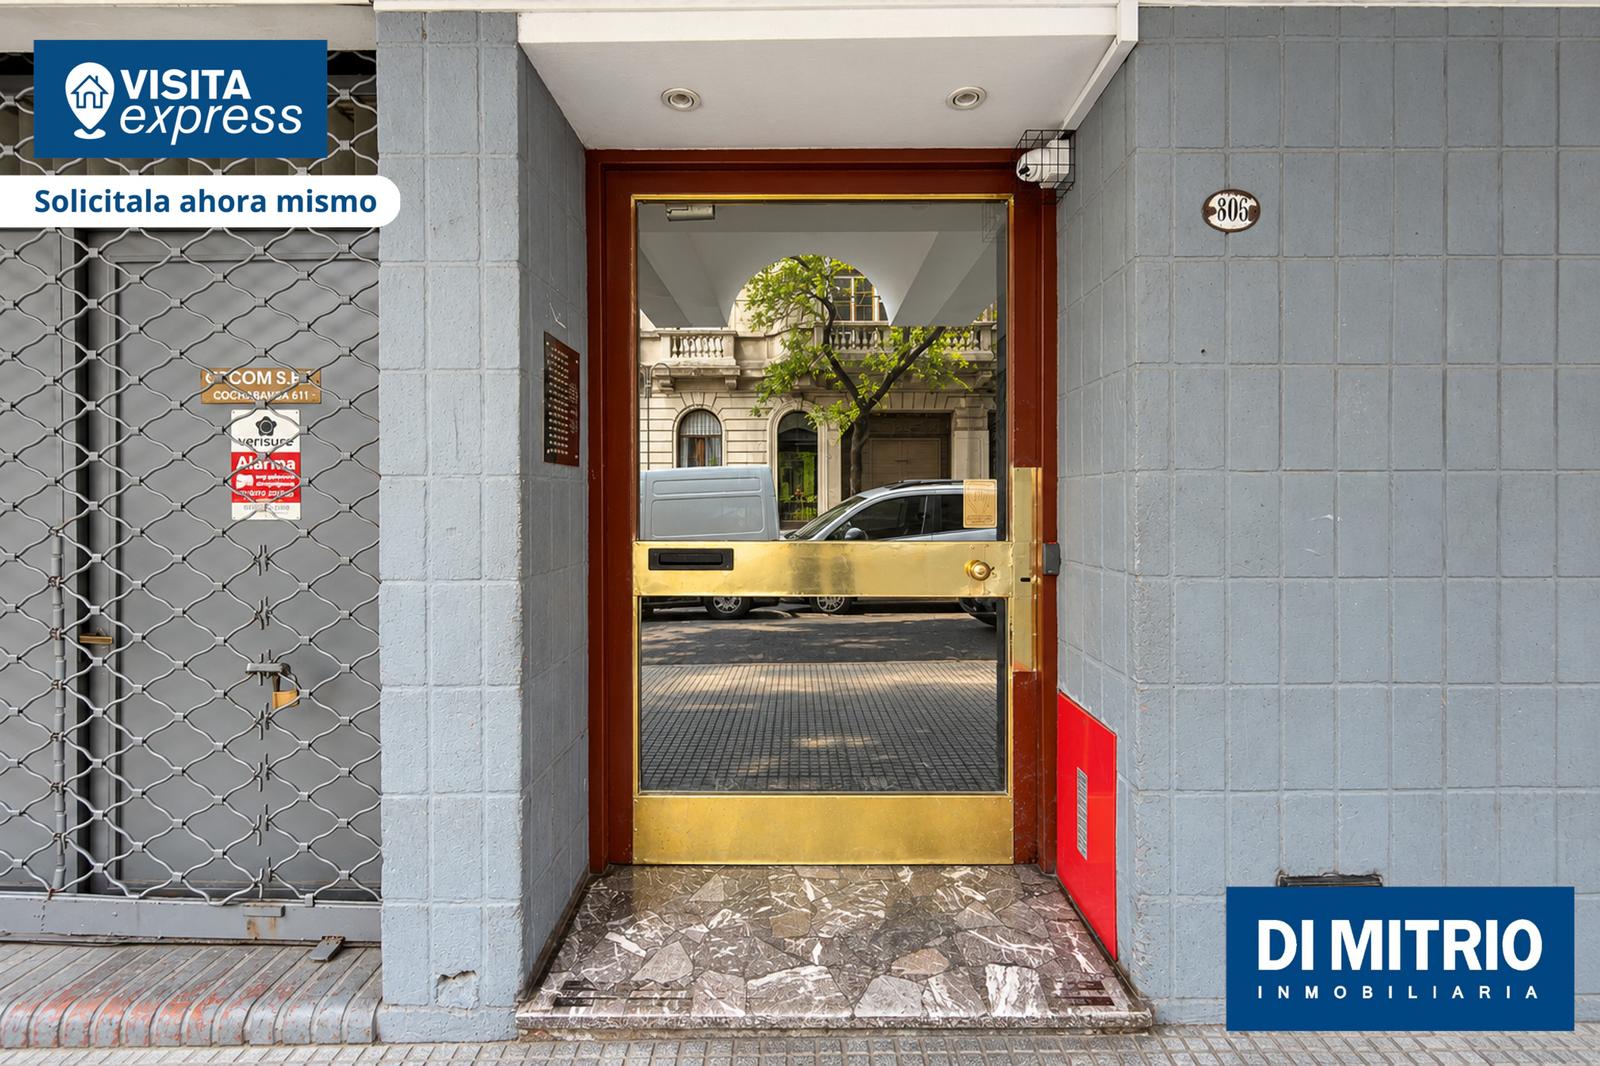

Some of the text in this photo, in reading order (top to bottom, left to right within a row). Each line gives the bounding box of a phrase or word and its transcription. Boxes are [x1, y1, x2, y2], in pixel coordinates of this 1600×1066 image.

[1217, 197, 1248, 222] 806
[205, 370, 272, 385] COM
[291, 390, 308, 400] 611
